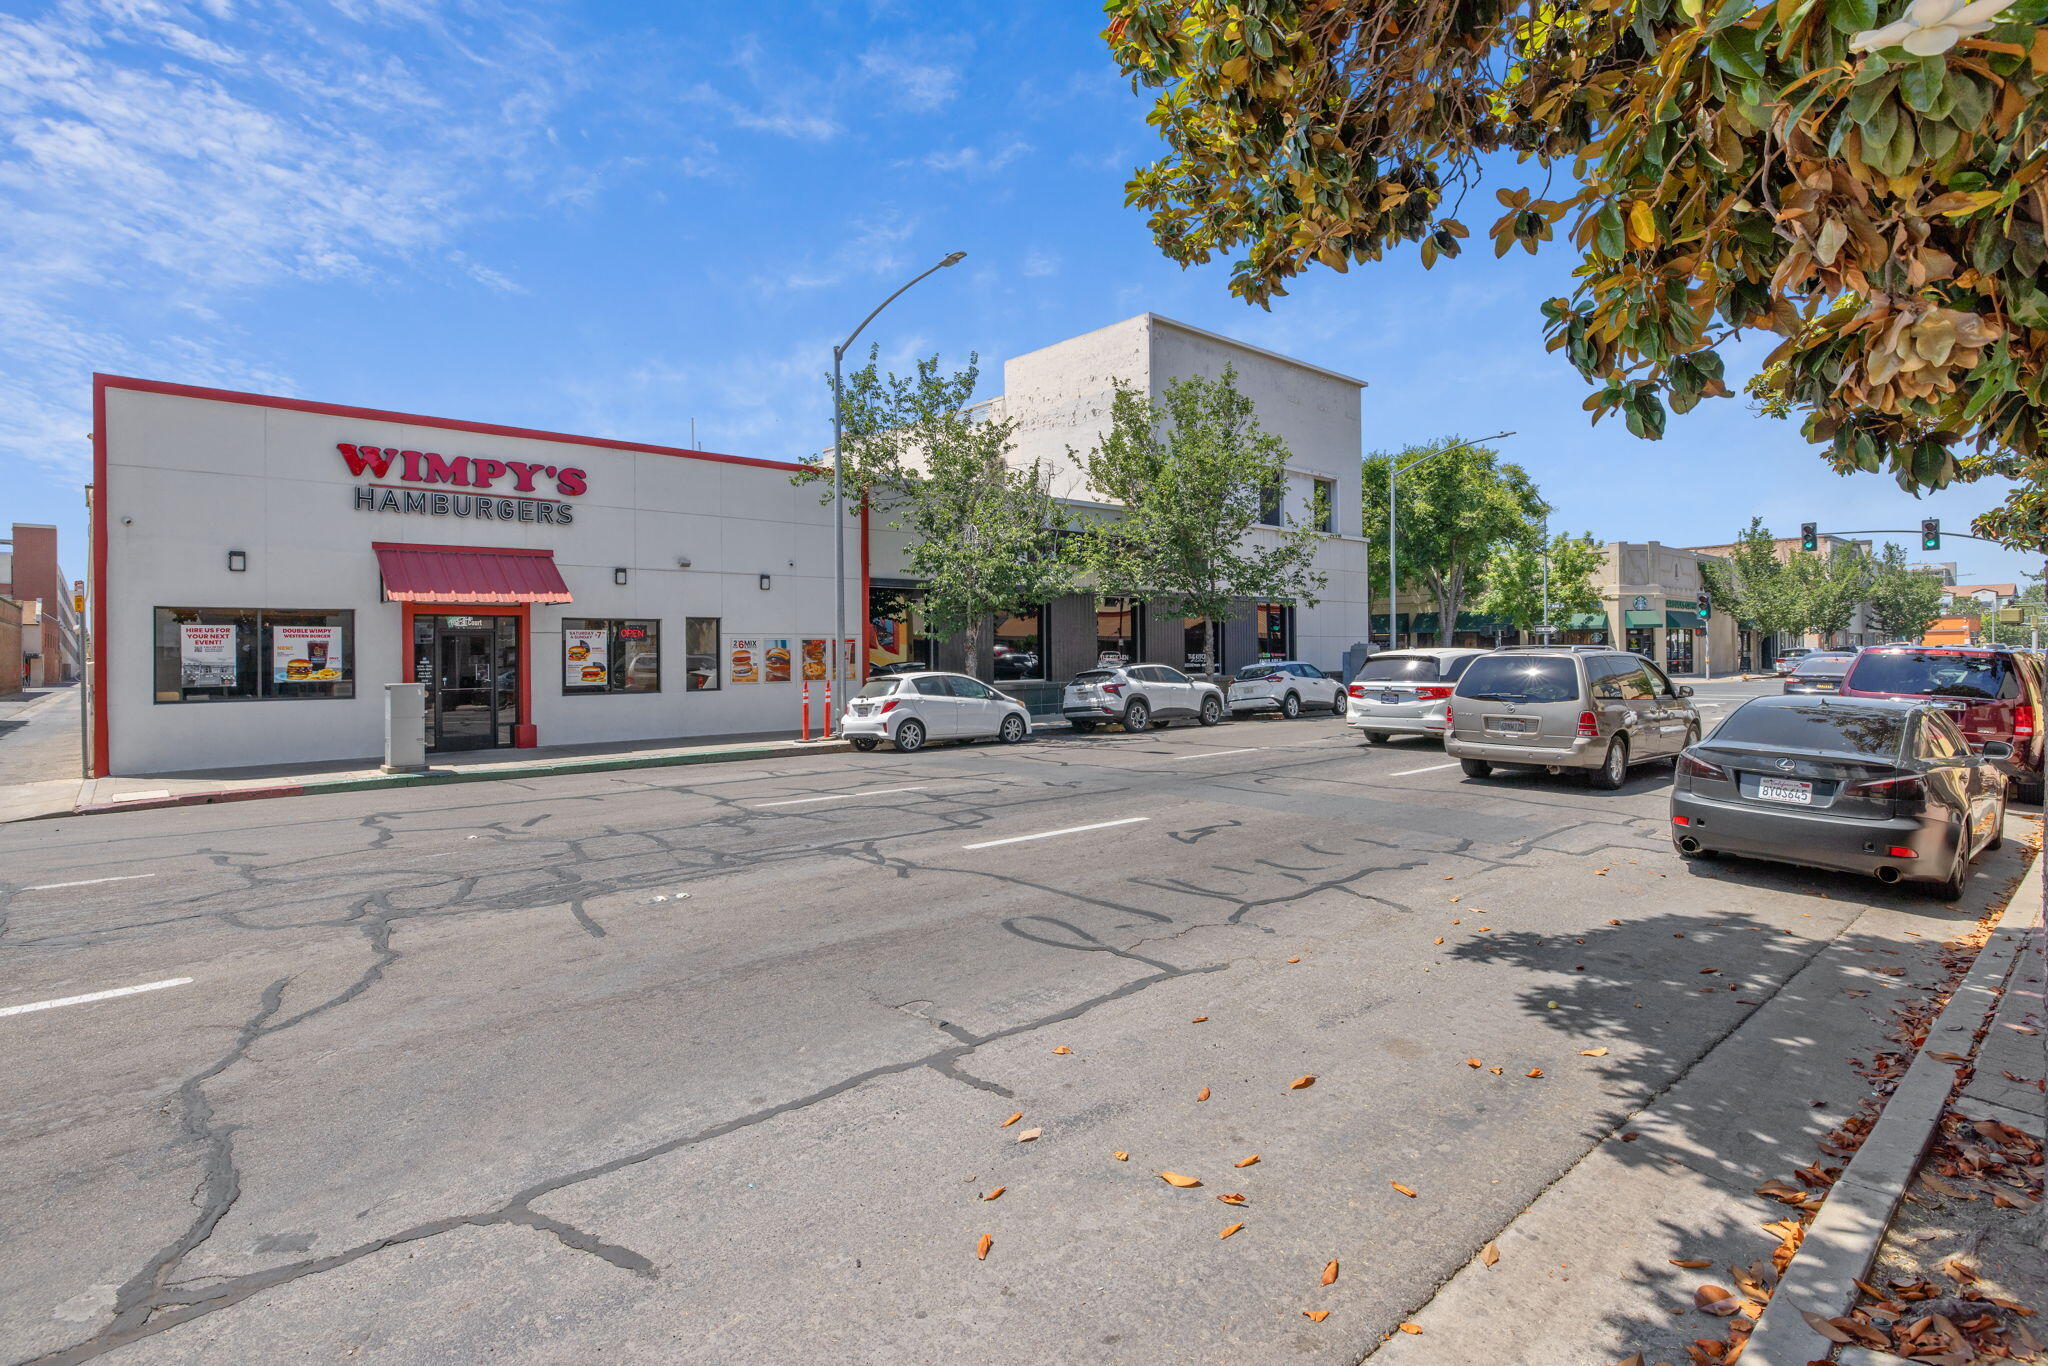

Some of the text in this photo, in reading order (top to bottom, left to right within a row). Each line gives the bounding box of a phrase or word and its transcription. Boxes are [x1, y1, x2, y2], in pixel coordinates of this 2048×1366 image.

[336, 443, 587, 496] WIMPY'S
[354, 487, 573, 524] HAMBURGERS
[621, 629, 645, 638] OPEN
